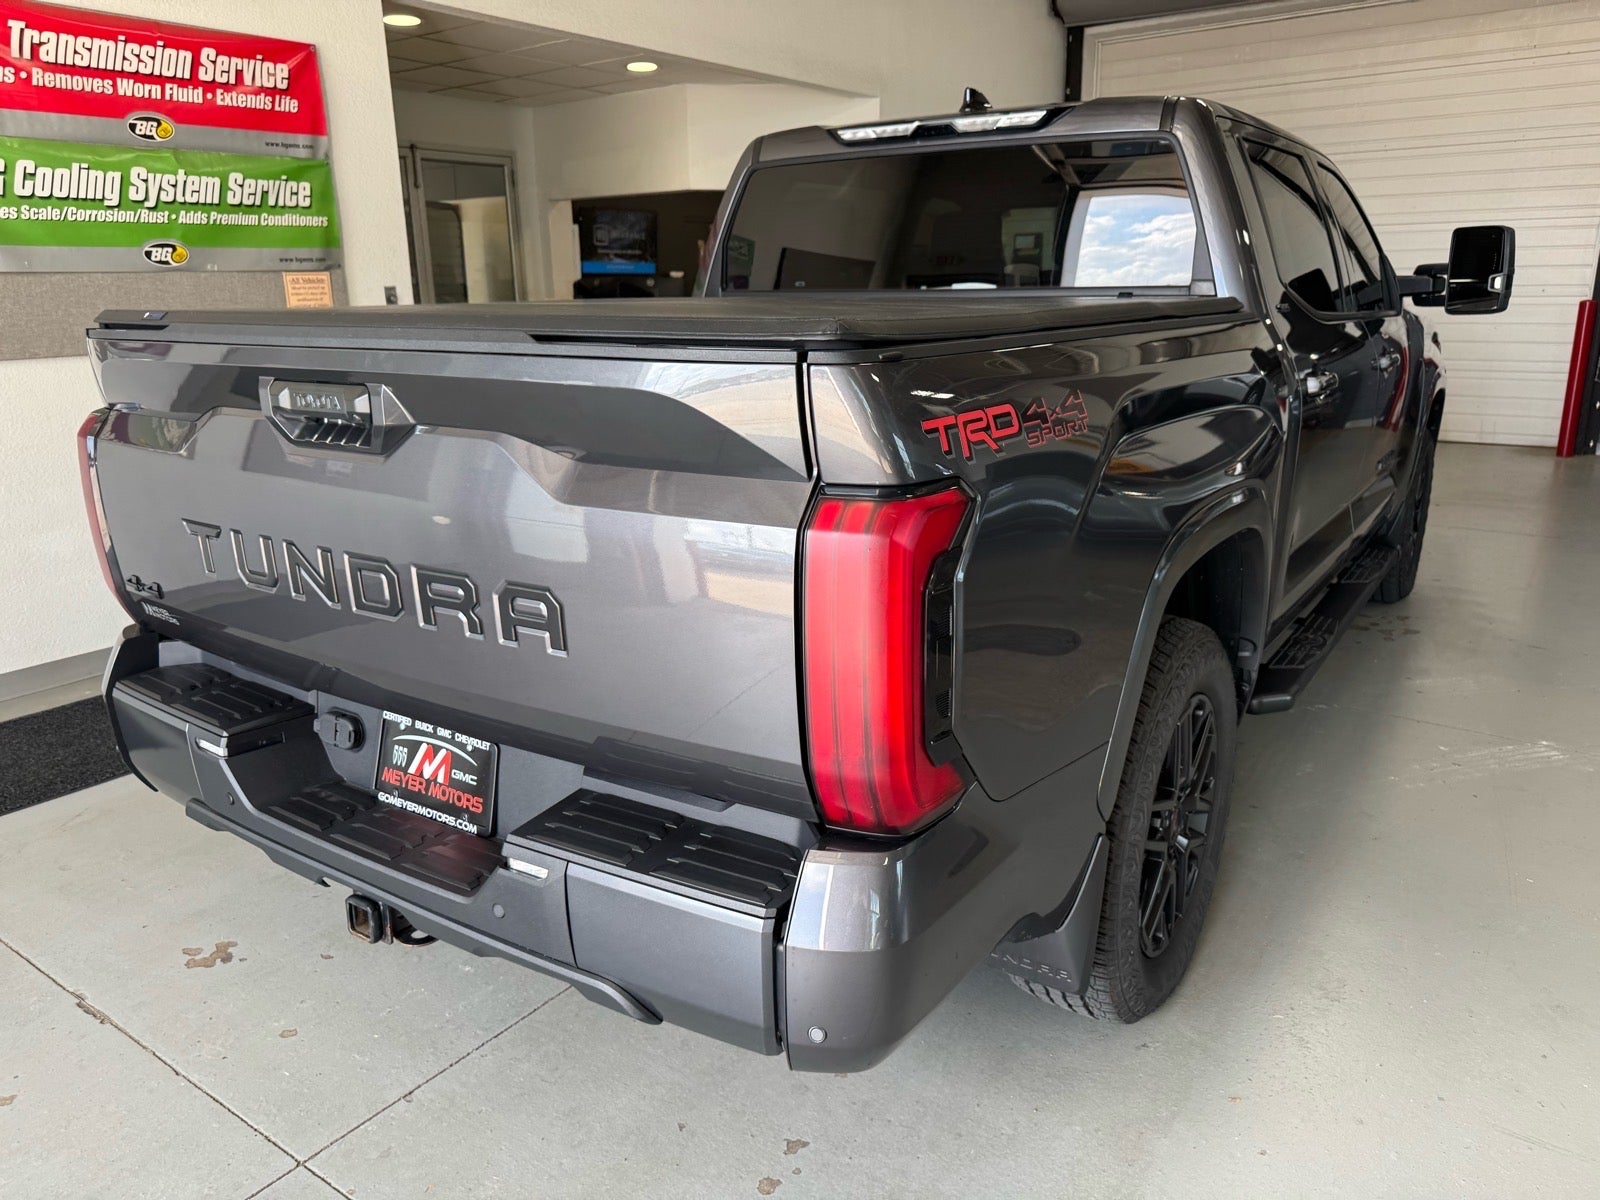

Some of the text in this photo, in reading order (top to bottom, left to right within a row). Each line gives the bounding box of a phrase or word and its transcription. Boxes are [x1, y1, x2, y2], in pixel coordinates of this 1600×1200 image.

[7, 18, 290, 90] Transmission Service
[0, 66, 299, 113] s Removes Worn Fluid Extends Life
[135, 120, 158, 136] BG
[14, 159, 122, 207] Cooling
[128, 166, 221, 208] System
[227, 172, 311, 208] Service
[21, 204, 169, 224] Scale/Corrosion/Rust
[178, 210, 208, 225] Adds
[210, 211, 258, 226] Premium
[260, 213, 328, 228] Conditioners
[151, 247, 173, 262] BG
[920, 403, 1021, 463] TRD
[1025, 417, 1090, 448] SPORT
[181, 517, 568, 658] TUNDRA
[383, 710, 491, 751] CERTIFIED BUICK GMC CHEVROLET
[382, 767, 484, 814] MEYER MOTORS
[451, 768, 478, 786] GMC
[378, 791, 478, 835] GOMEYERMOTORS.COM
